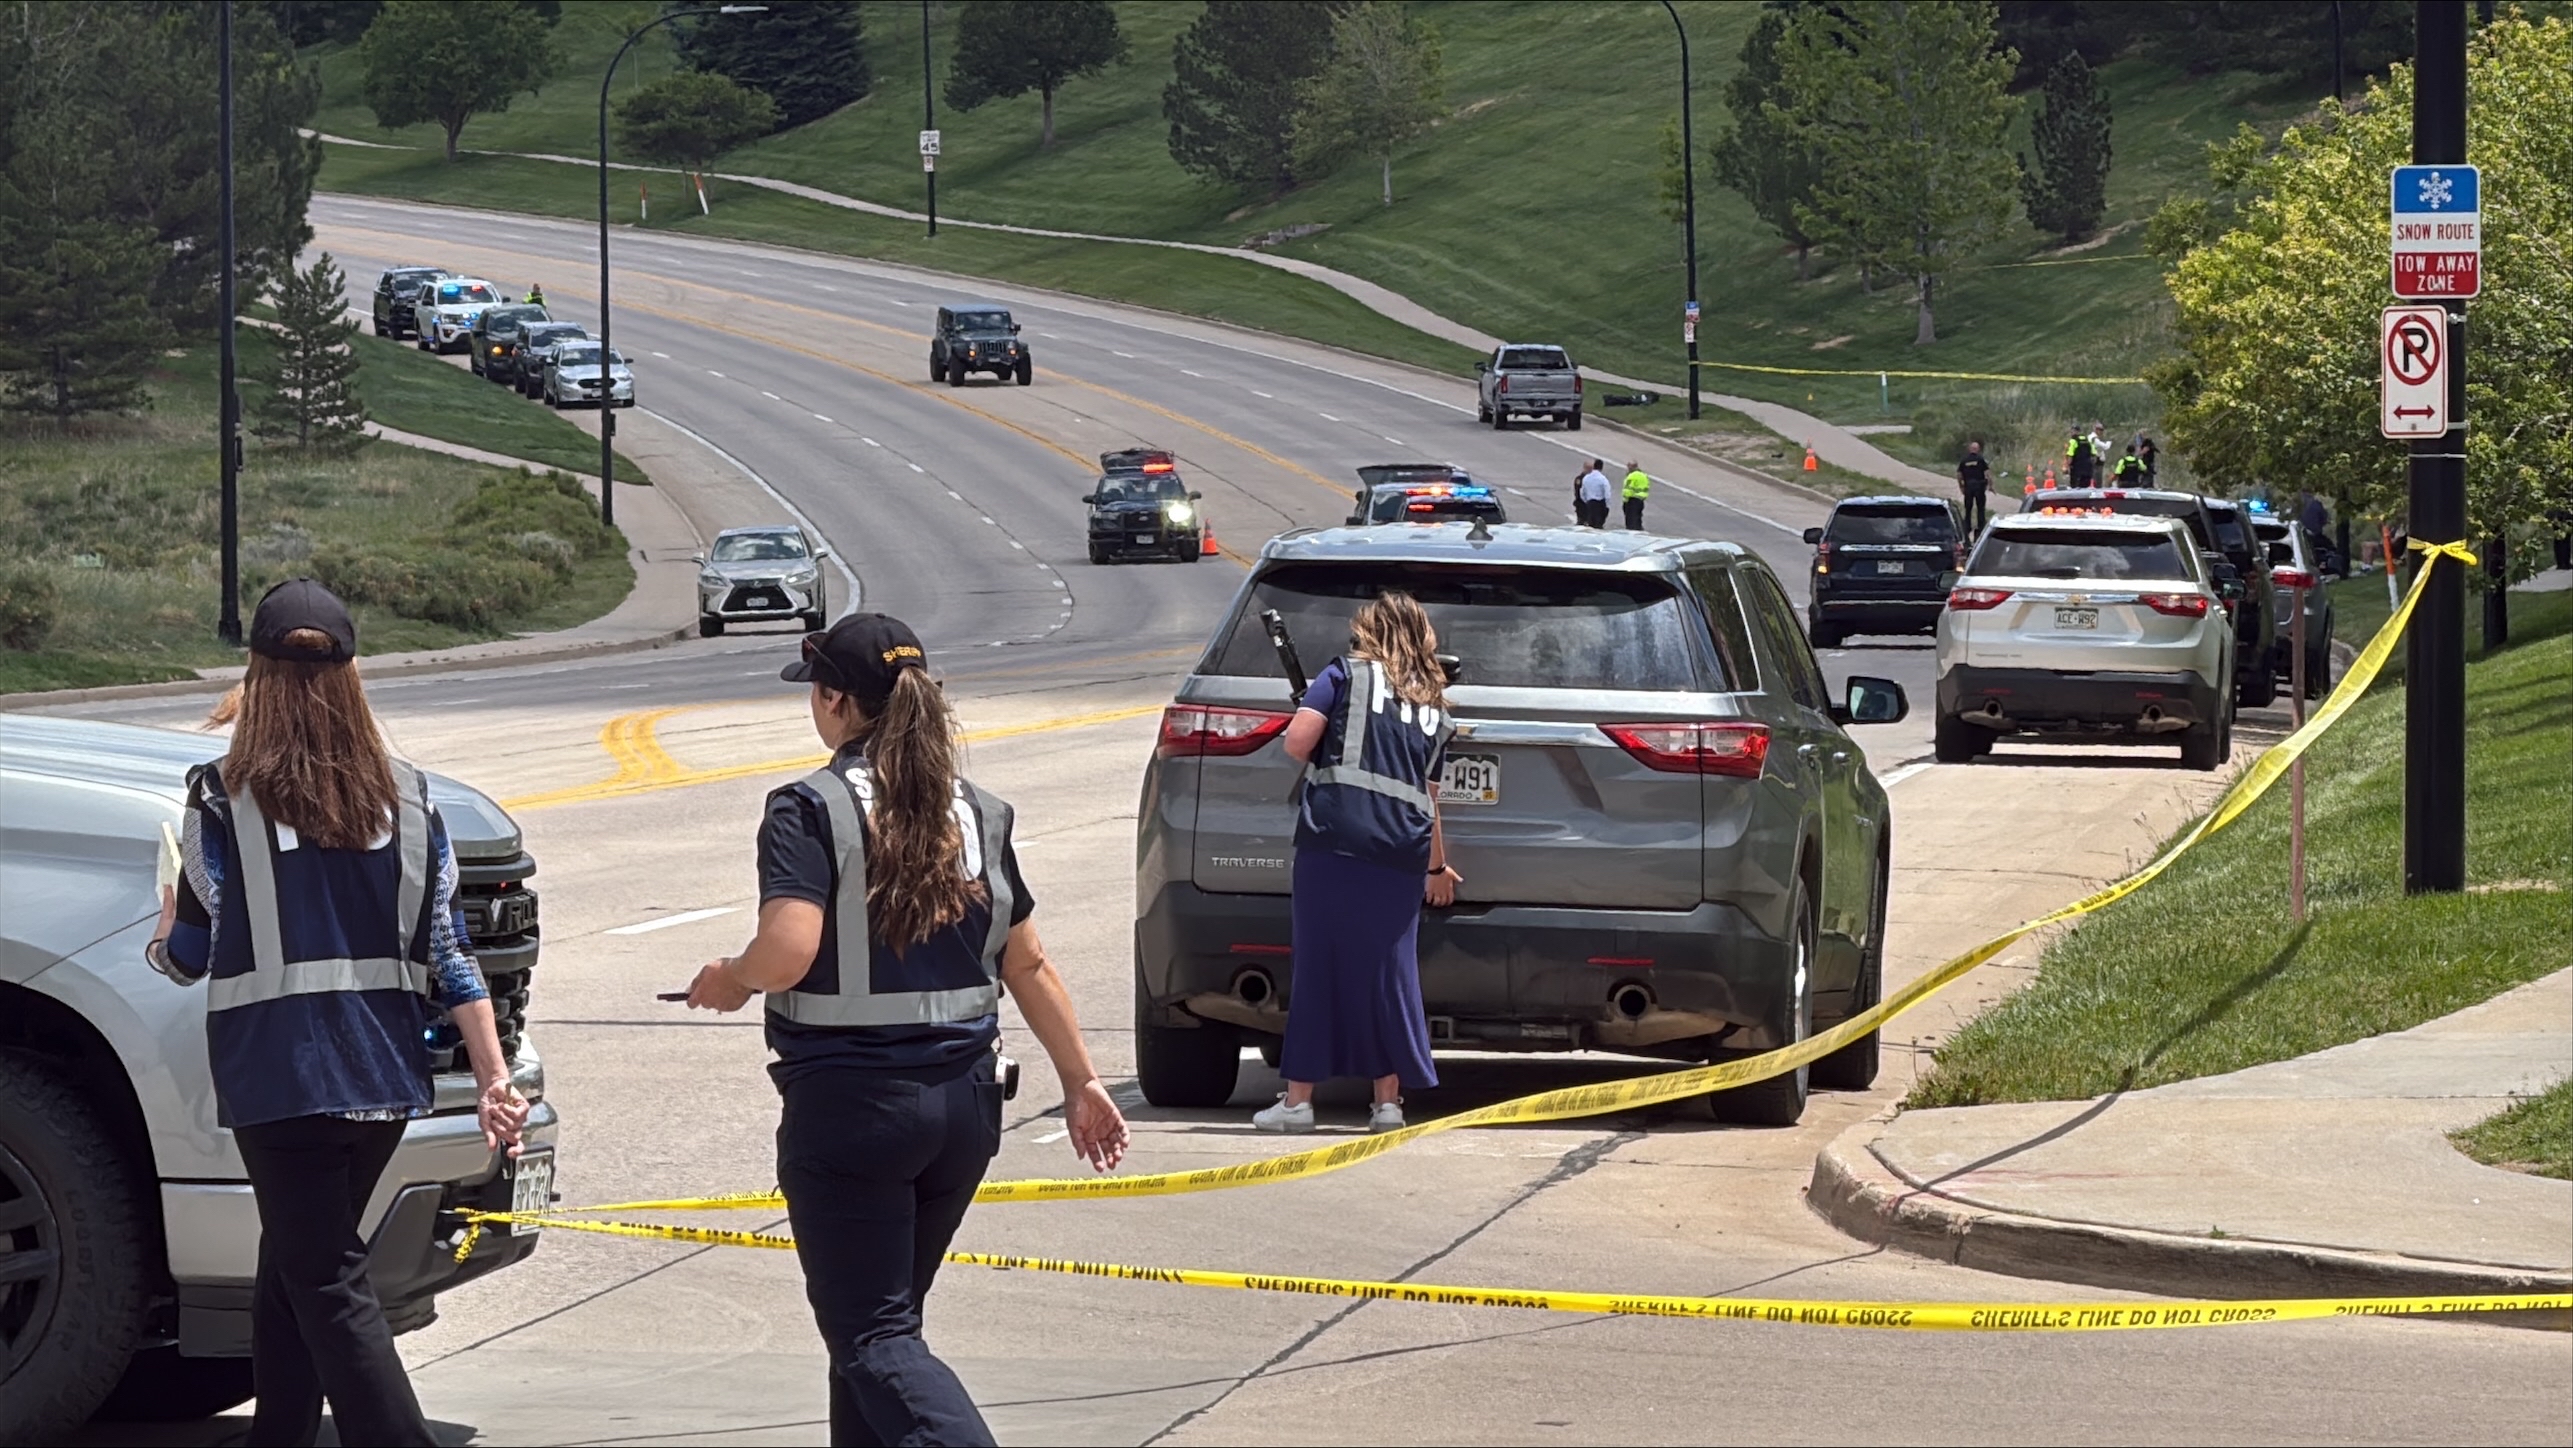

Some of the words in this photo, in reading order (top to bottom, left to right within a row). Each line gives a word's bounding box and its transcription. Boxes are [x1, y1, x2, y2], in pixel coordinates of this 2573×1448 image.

[922, 143, 938, 152] 45
[2397, 224, 2431, 241] SNOW
[2437, 224, 2474, 240] ROUTE
[2398, 256, 2426, 272] TOW
[2436, 256, 2474, 272] AWAY
[2417, 275, 2455, 292] ZONE
[1211, 856, 1285, 869] TRAVERSE
